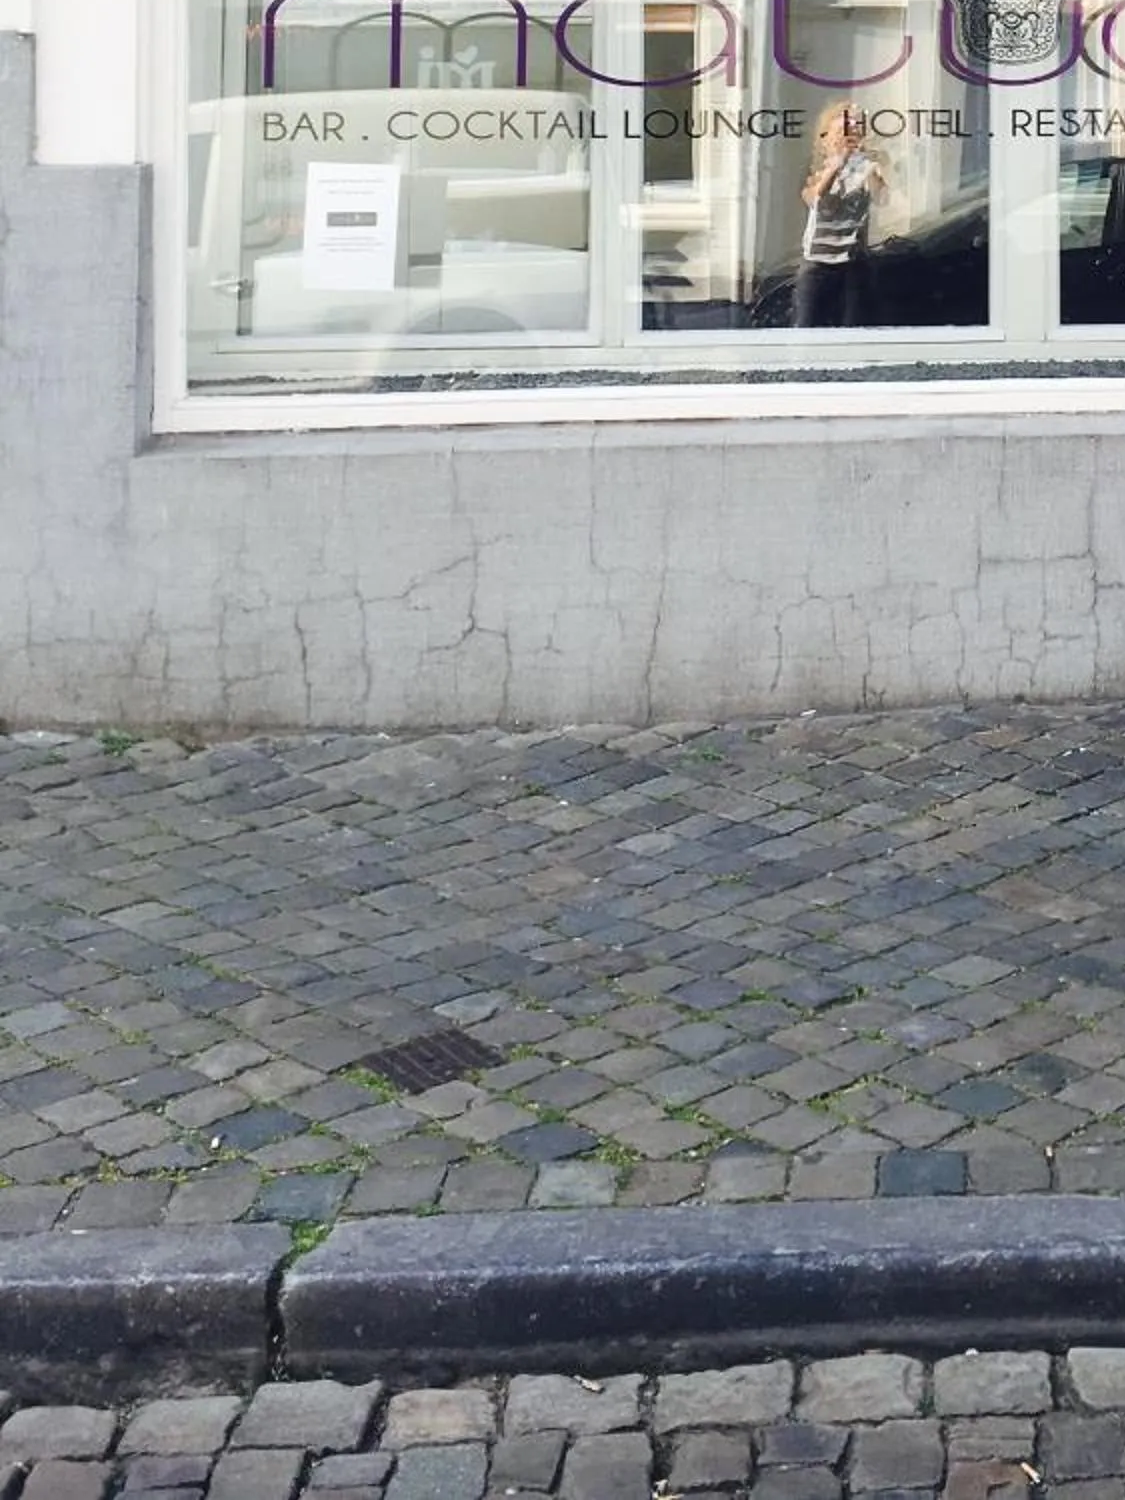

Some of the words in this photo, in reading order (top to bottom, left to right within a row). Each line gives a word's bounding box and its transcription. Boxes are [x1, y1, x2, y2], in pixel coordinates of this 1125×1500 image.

[262, 111, 346, 141] BAR
[387, 110, 609, 140] COCKTAIL
[624, 109, 807, 139] LOUNGE
[842, 108, 972, 139] HOTEL
